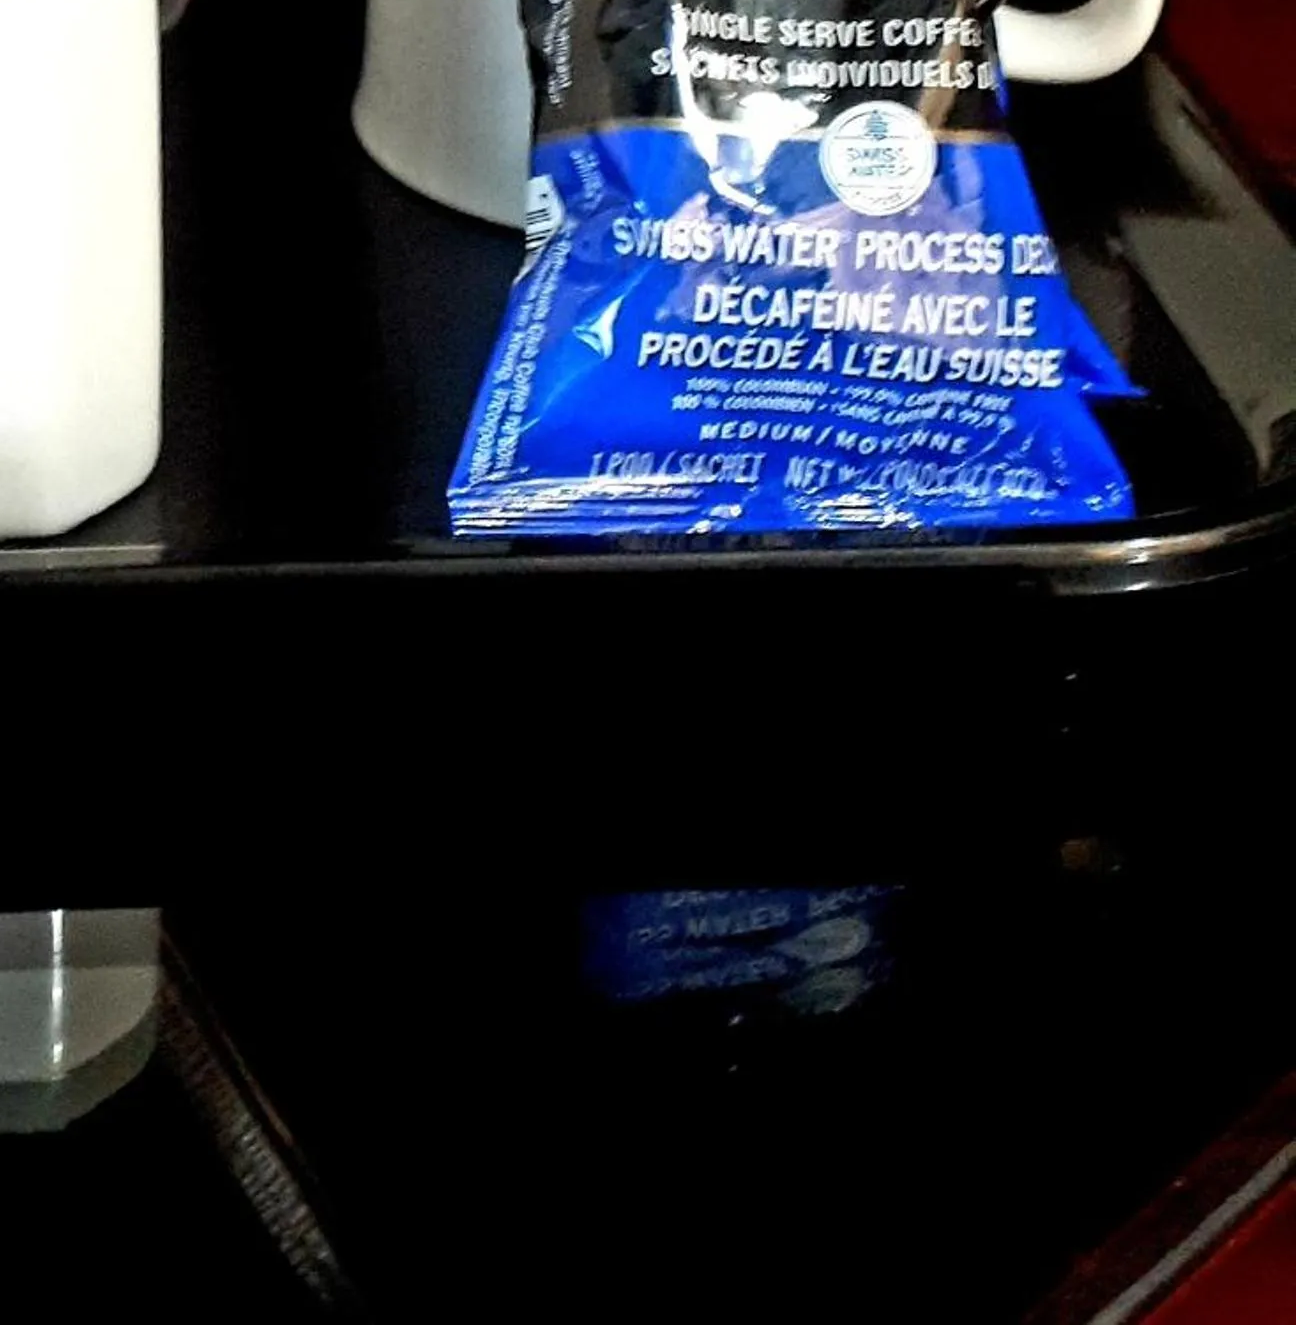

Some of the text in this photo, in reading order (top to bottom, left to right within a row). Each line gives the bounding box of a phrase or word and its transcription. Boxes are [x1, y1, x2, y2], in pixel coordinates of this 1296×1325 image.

[672, 3, 984, 48] INGLE SERVE COFFE
[650, 48, 781, 84] SCHETS
[612, 217, 713, 261] SWISS
[714, 220, 838, 269] WATER
[855, 229, 1004, 274] PROCESS
[692, 273, 1038, 338] DÉCAFÉINÉ AVEC LE
[636, 327, 1067, 388] PROCÉDÉ À L'EAU SUISSE
